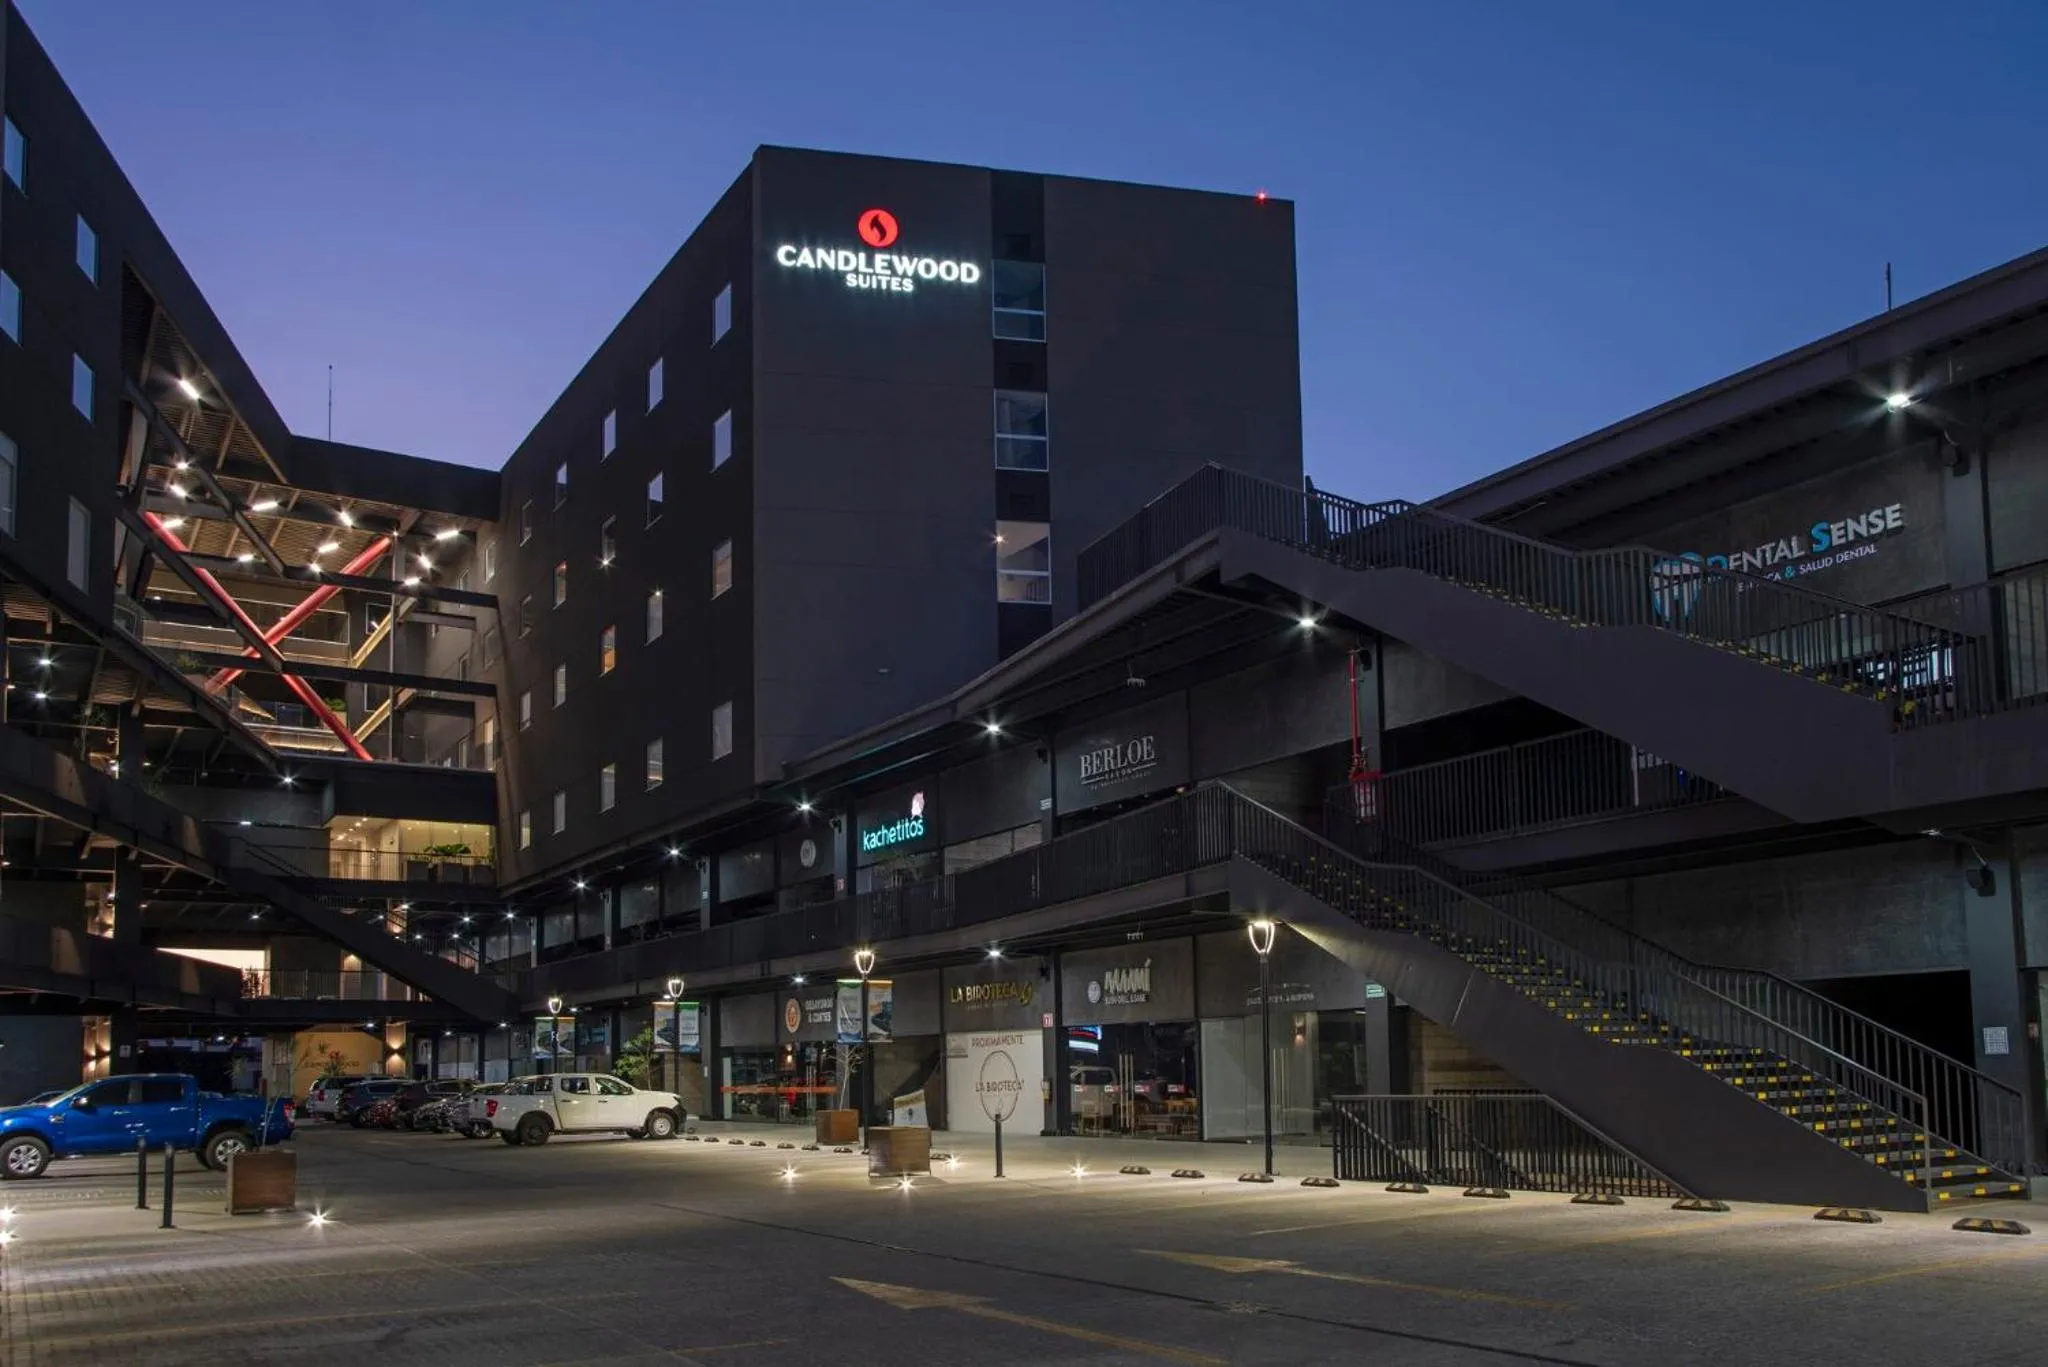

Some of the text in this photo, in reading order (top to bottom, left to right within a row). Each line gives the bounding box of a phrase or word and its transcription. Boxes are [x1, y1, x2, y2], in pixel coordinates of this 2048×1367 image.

[777, 245, 981, 284] CANDLEWOOD
[845, 273, 914, 293] SUITES
[1811, 503, 1903, 553] SENSE
[1799, 556, 1834, 576] SALUD
[1835, 544, 1878, 564] DENTAL
[1080, 735, 1155, 778] BERLOE
[862, 817, 924, 851] kachetitos
[950, 981, 1018, 1004] LA BIROTECA
[971, 1034, 1024, 1048] PROXIMAMENTE
[975, 1082, 985, 1093] LA
